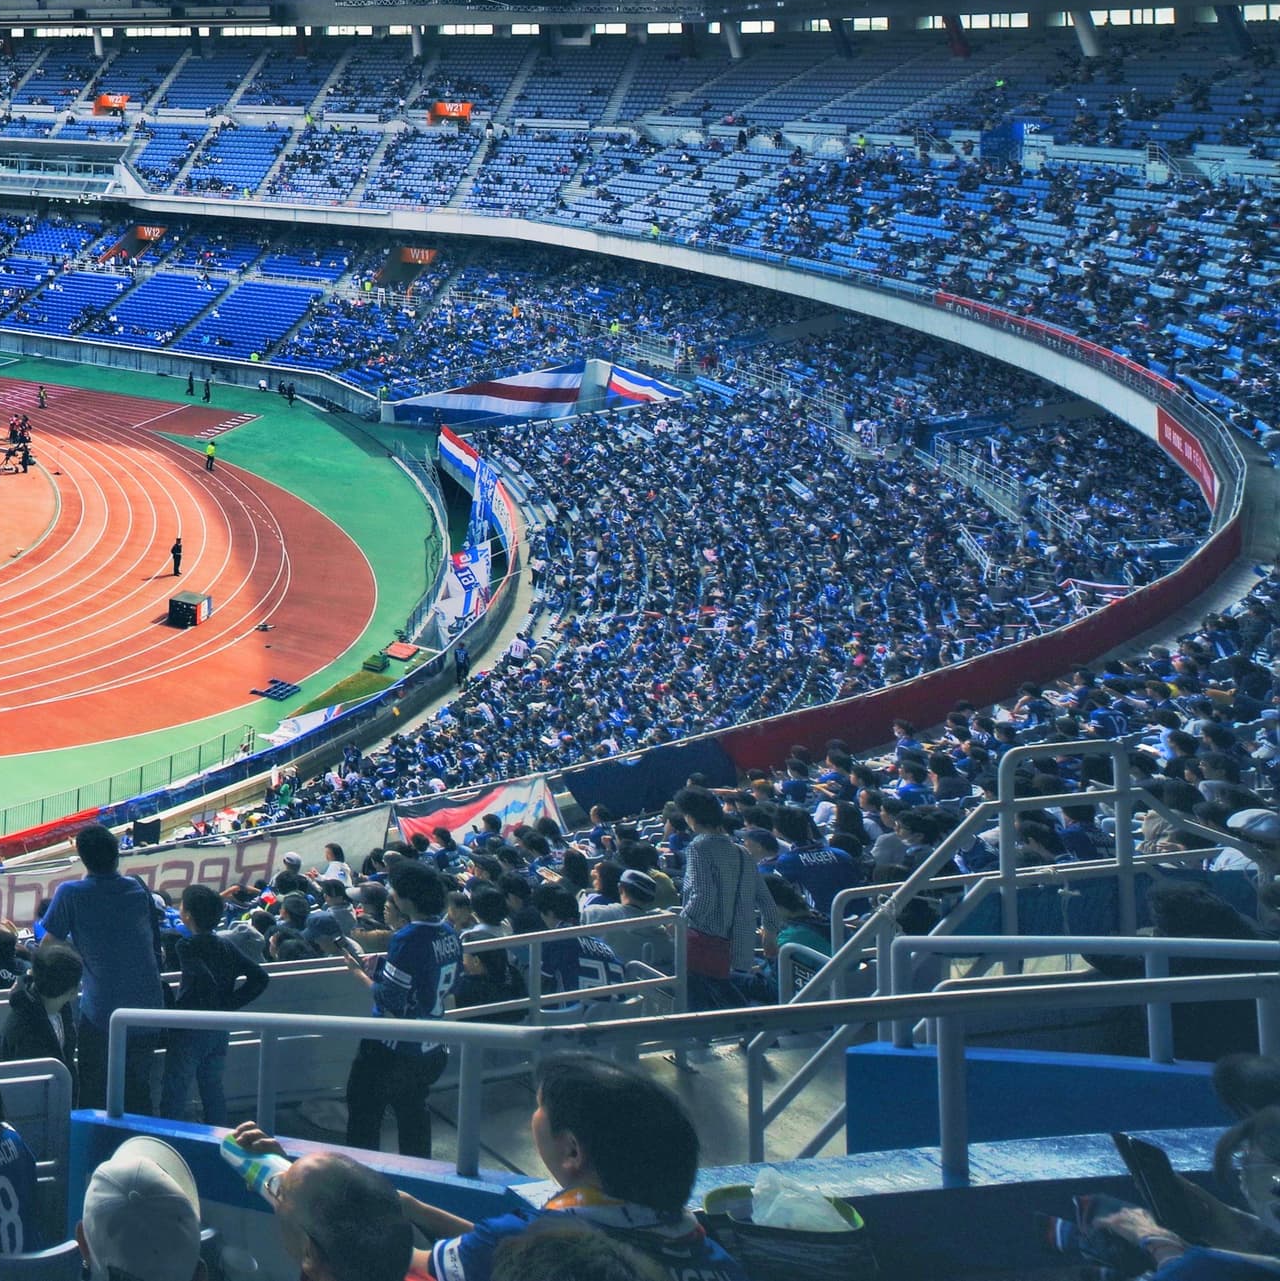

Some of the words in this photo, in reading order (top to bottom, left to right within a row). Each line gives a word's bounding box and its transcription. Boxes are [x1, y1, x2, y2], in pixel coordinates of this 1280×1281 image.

[108, 95, 123, 103] W22
[445, 103, 464, 112] W21
[143, 226, 160, 237] W12
[410, 249, 429, 260] W11
[798, 850, 837, 866] MUGEN
[577, 935, 616, 957] MUGEN
